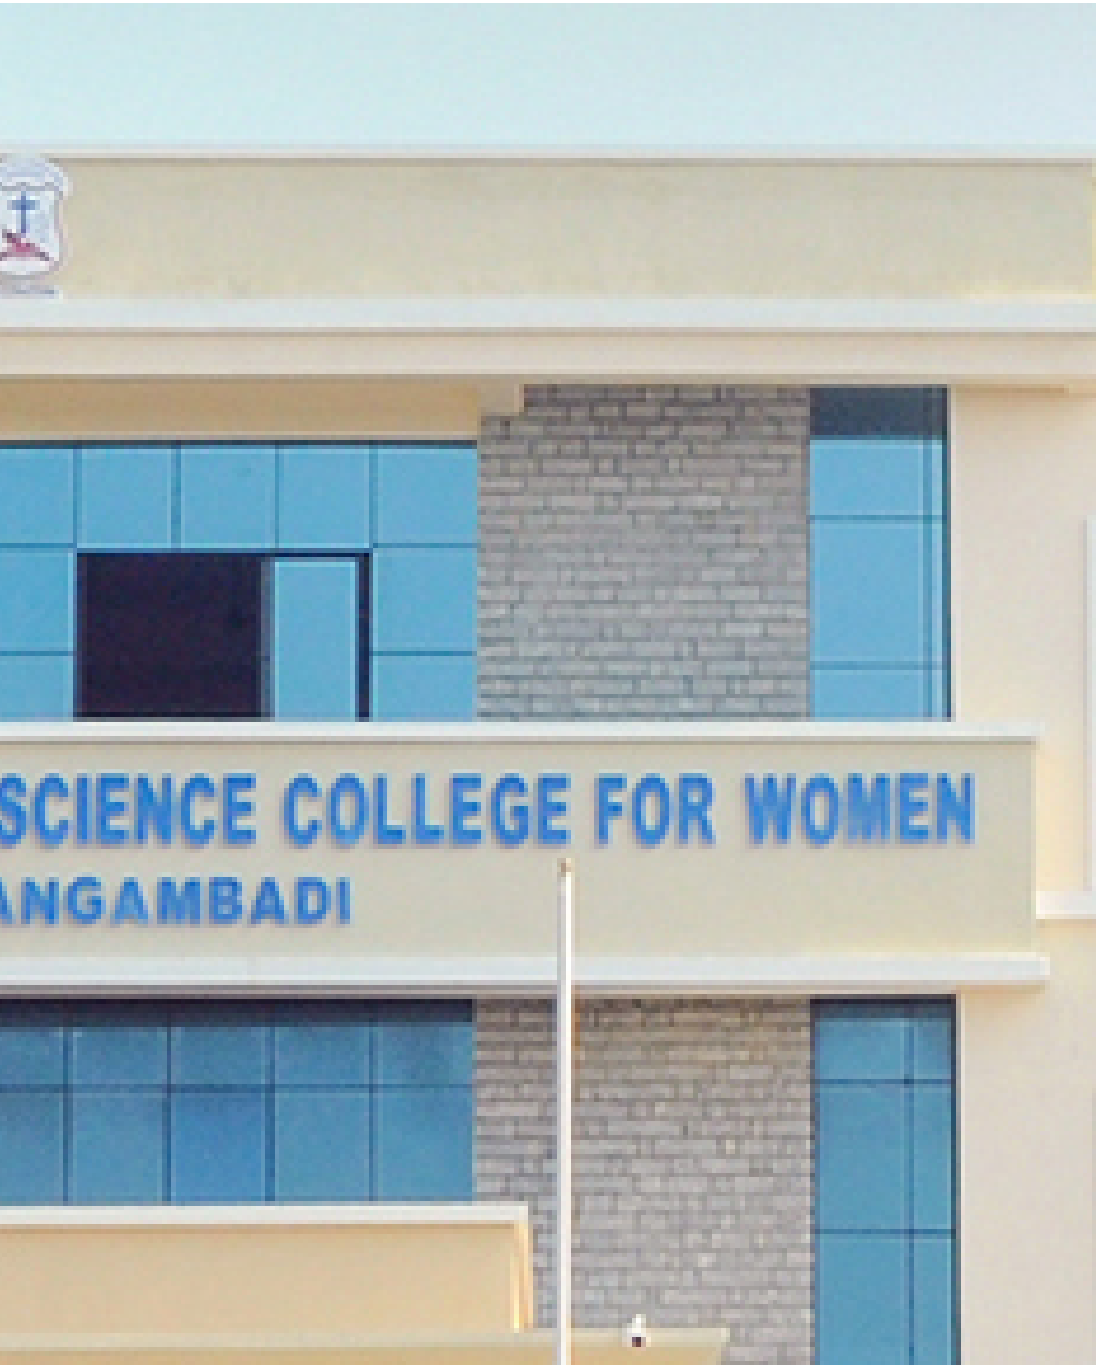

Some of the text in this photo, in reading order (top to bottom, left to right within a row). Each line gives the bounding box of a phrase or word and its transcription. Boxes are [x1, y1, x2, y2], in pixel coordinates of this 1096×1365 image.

[283, 773, 572, 846] COLLEGE
[596, 773, 714, 844] FOR
[744, 773, 976, 844] WOMEN
